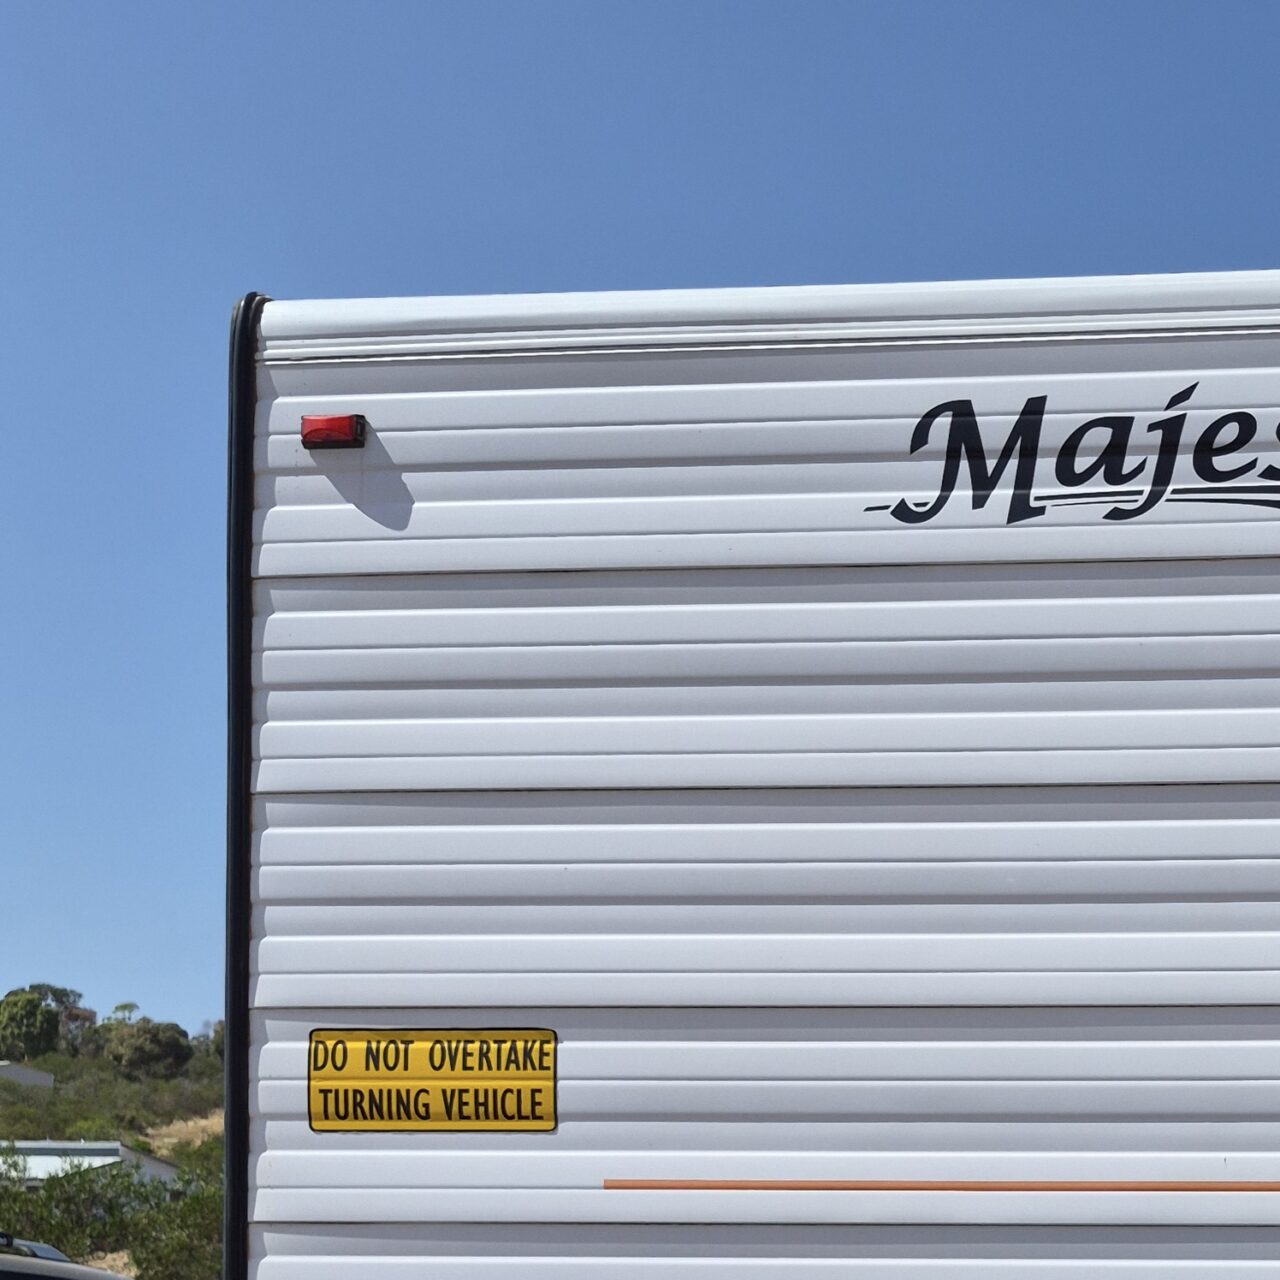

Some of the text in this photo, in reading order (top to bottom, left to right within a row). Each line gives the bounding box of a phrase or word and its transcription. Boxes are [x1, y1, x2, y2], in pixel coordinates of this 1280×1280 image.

[313, 1039, 551, 1072] DO NOT OVERTAKE
[318, 1088, 544, 1121] TURNING VEHICLE
